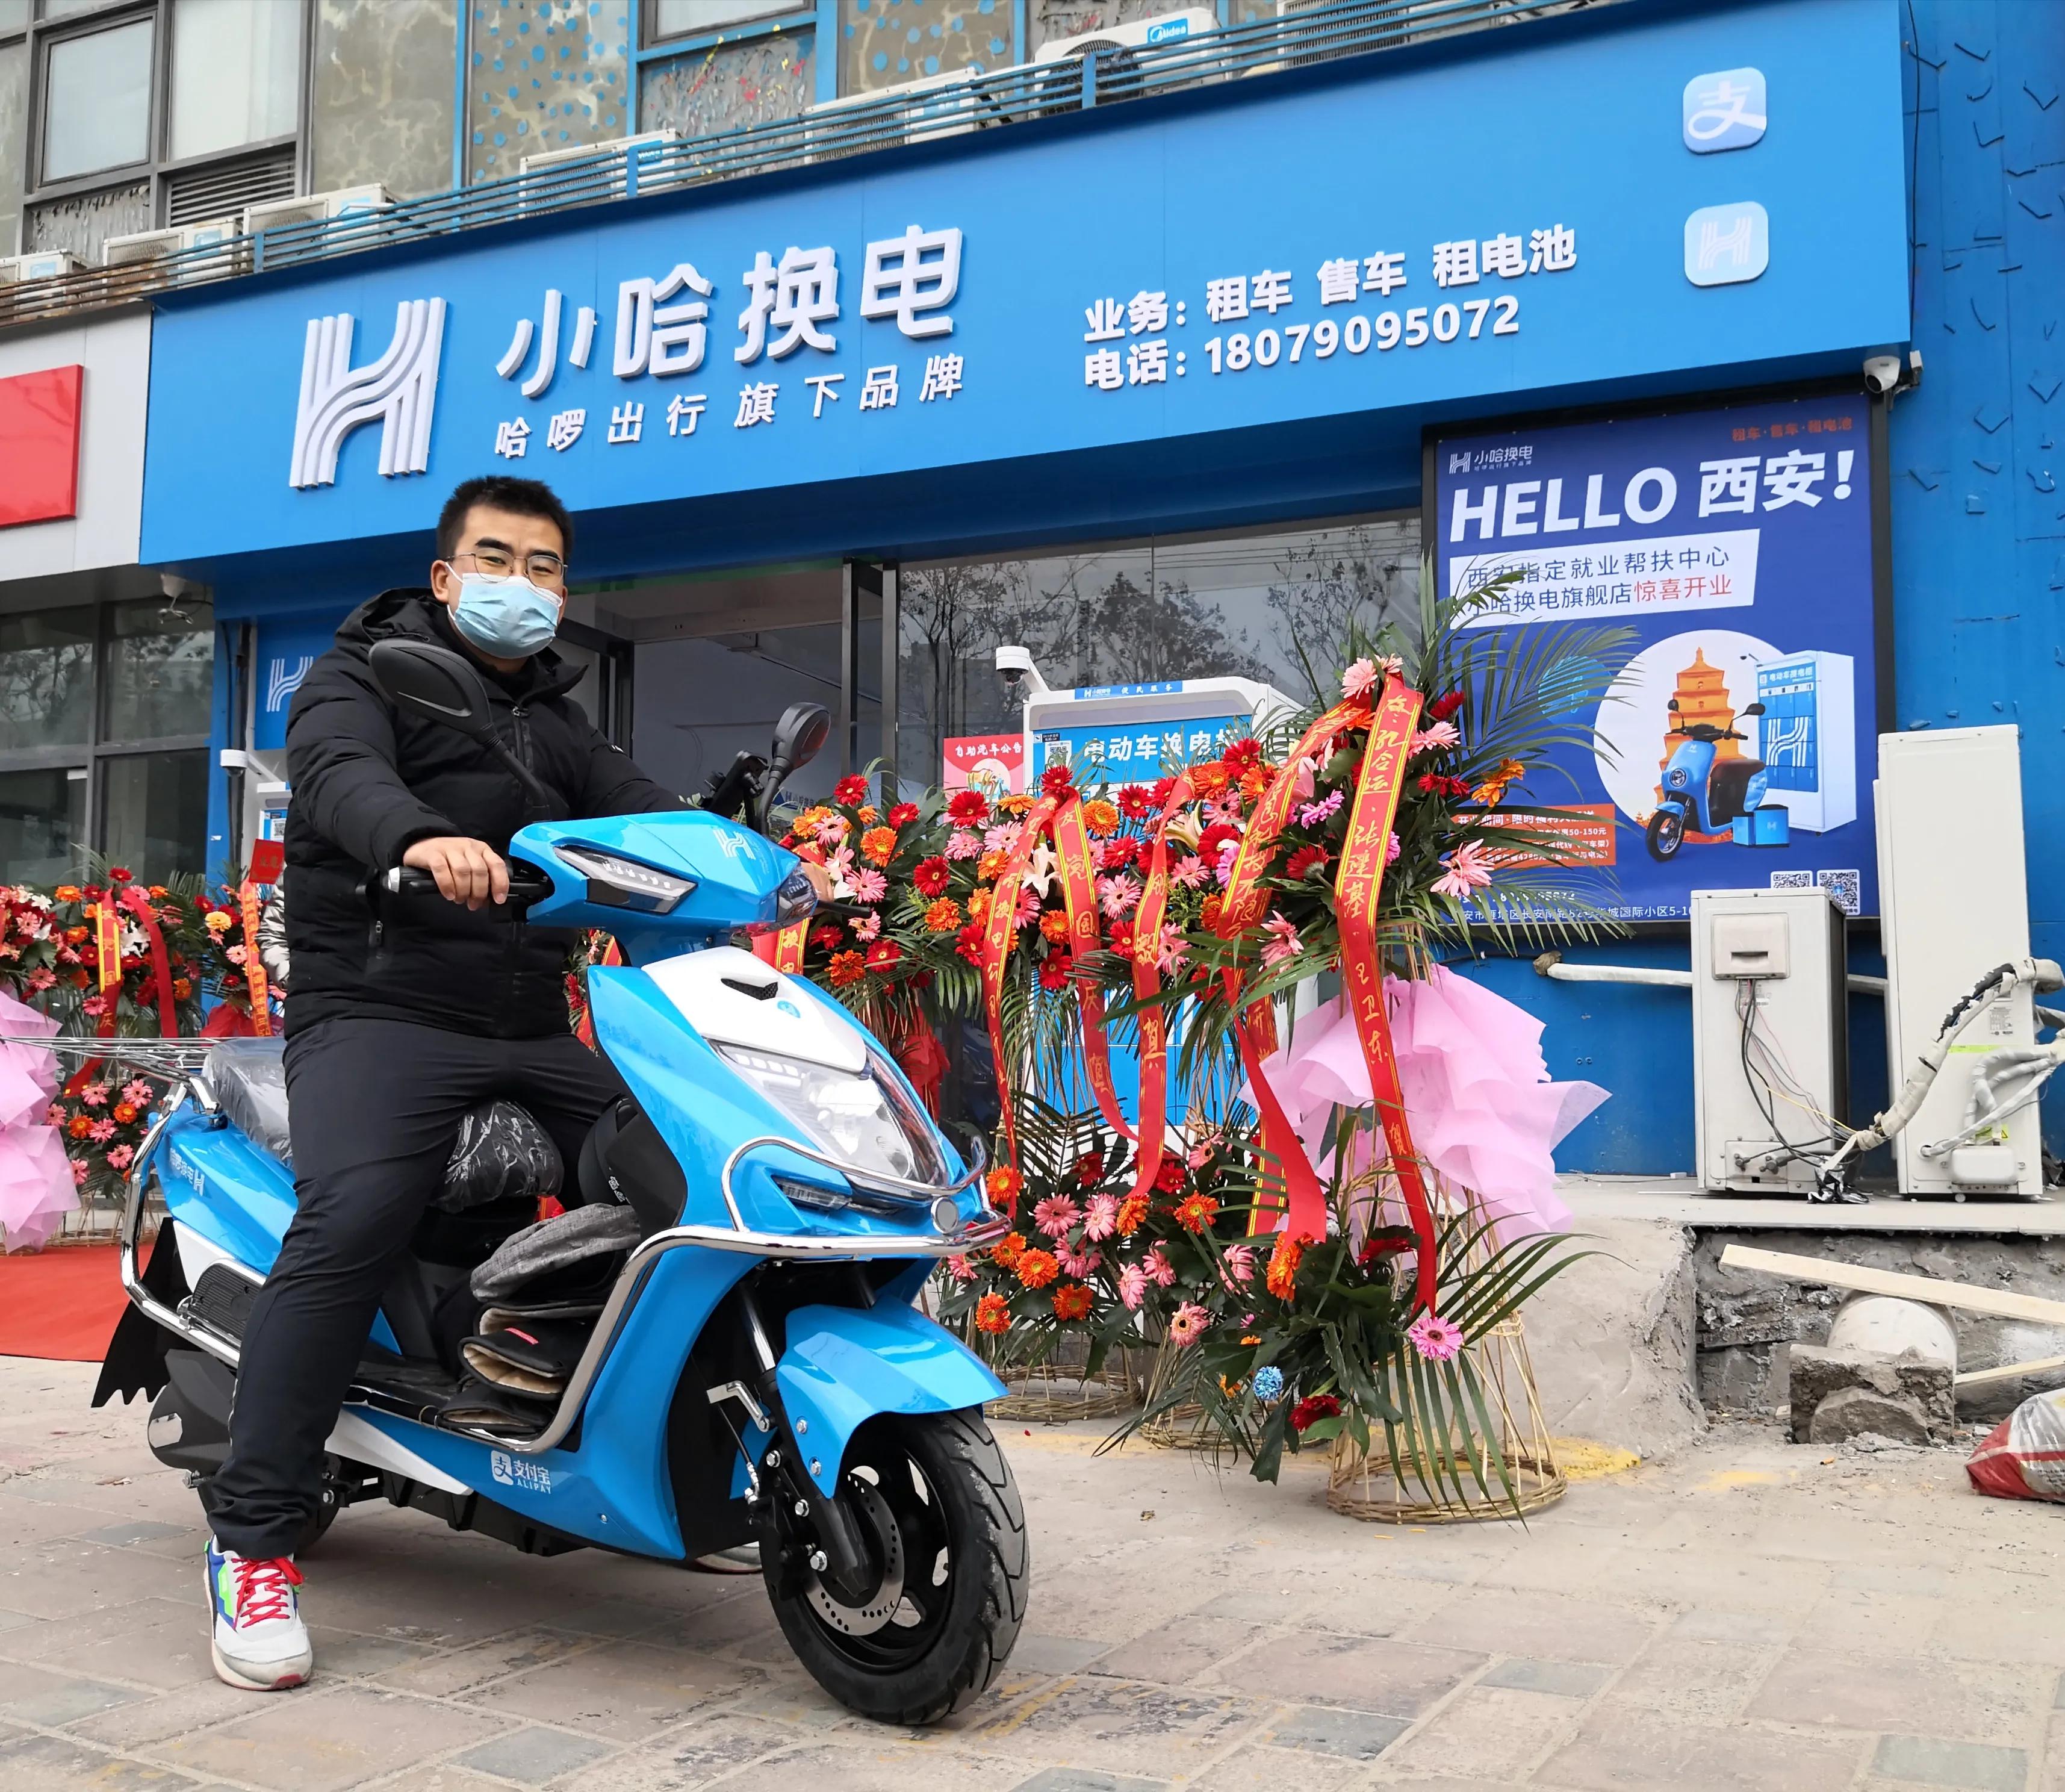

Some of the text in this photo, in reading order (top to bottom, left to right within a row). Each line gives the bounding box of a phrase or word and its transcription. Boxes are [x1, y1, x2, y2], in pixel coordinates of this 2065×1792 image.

[495, 225, 963, 398] 小哈换电
[1205, 270, 1293, 324] 租车
[1316, 250, 1407, 306] 售车
[1432, 223, 1578, 288] 租电池
[1204, 295, 1520, 375] 18079095072
[494, 352, 964, 459] 哈啰出行旗下品牌
[1474, 445, 1533, 465] 小哈换电
[1450, 449, 1855, 542] HELLO 西安！
[1467, 546, 1730, 588] 西安指定就业帮扶中心
[514, 1460, 551, 1486] 支付宝
[517, 1478, 552, 1495] ALIPAY
